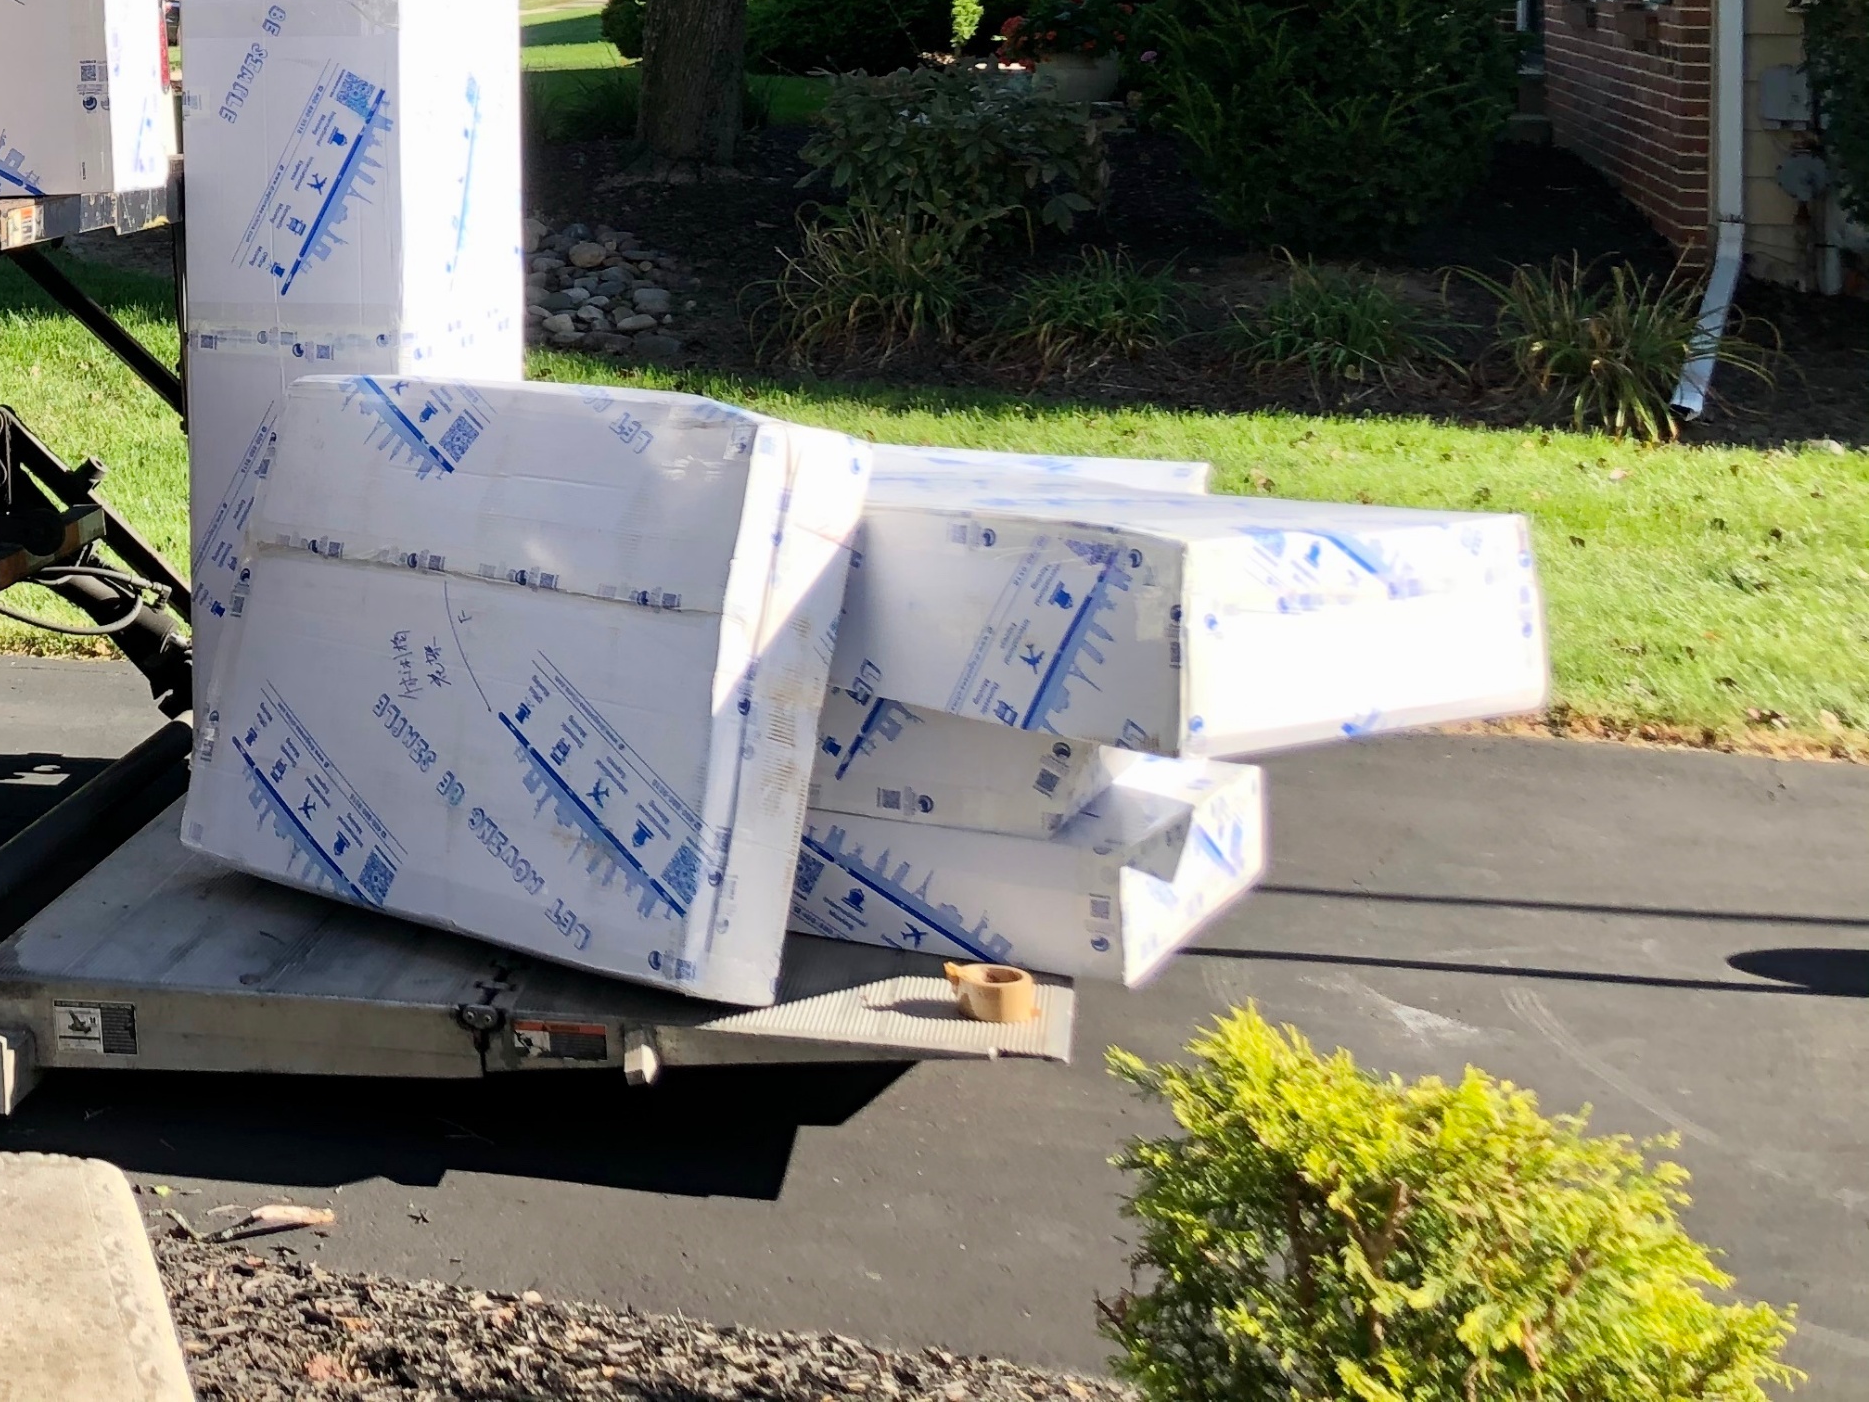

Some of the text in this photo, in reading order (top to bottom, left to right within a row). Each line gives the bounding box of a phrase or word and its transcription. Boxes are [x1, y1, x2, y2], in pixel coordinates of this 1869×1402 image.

[262, 4, 286, 36] BE
[218, 42, 268, 123] SIMPLE
[608, 412, 654, 454] LET
[372, 693, 592, 951] LET MOVING BE SIMPLE
